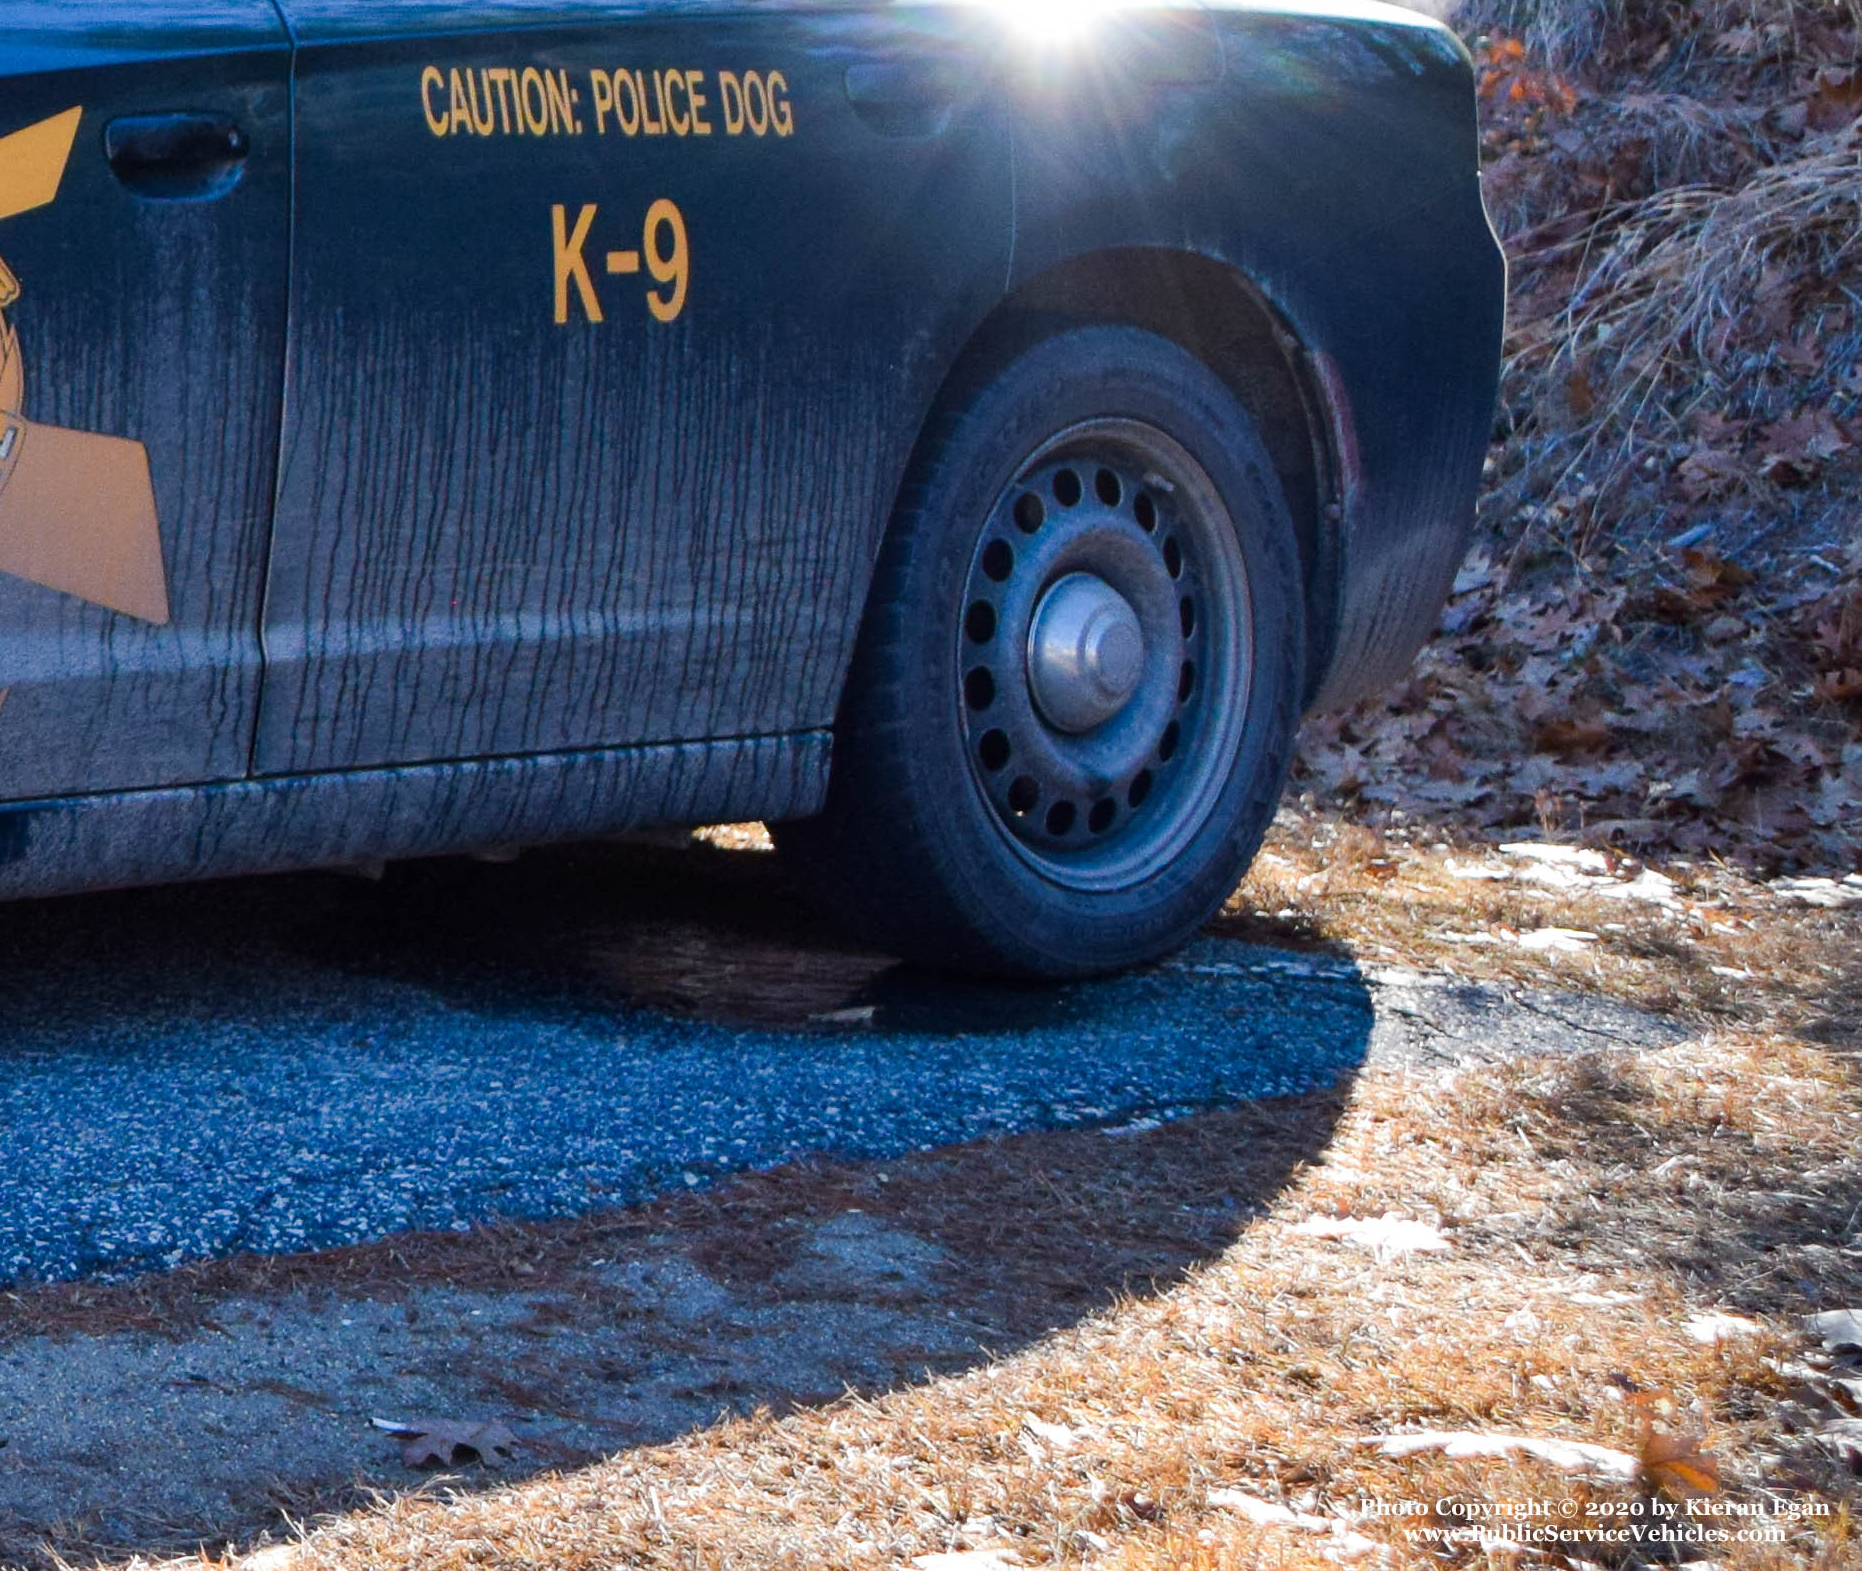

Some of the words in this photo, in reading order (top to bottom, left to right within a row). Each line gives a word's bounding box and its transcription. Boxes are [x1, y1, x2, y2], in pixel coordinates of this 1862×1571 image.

[421, 66, 583, 137] CAUTION:
[590, 67, 712, 137] POLICE
[719, 69, 794, 137] DOG
[552, 197, 690, 324] K-9
